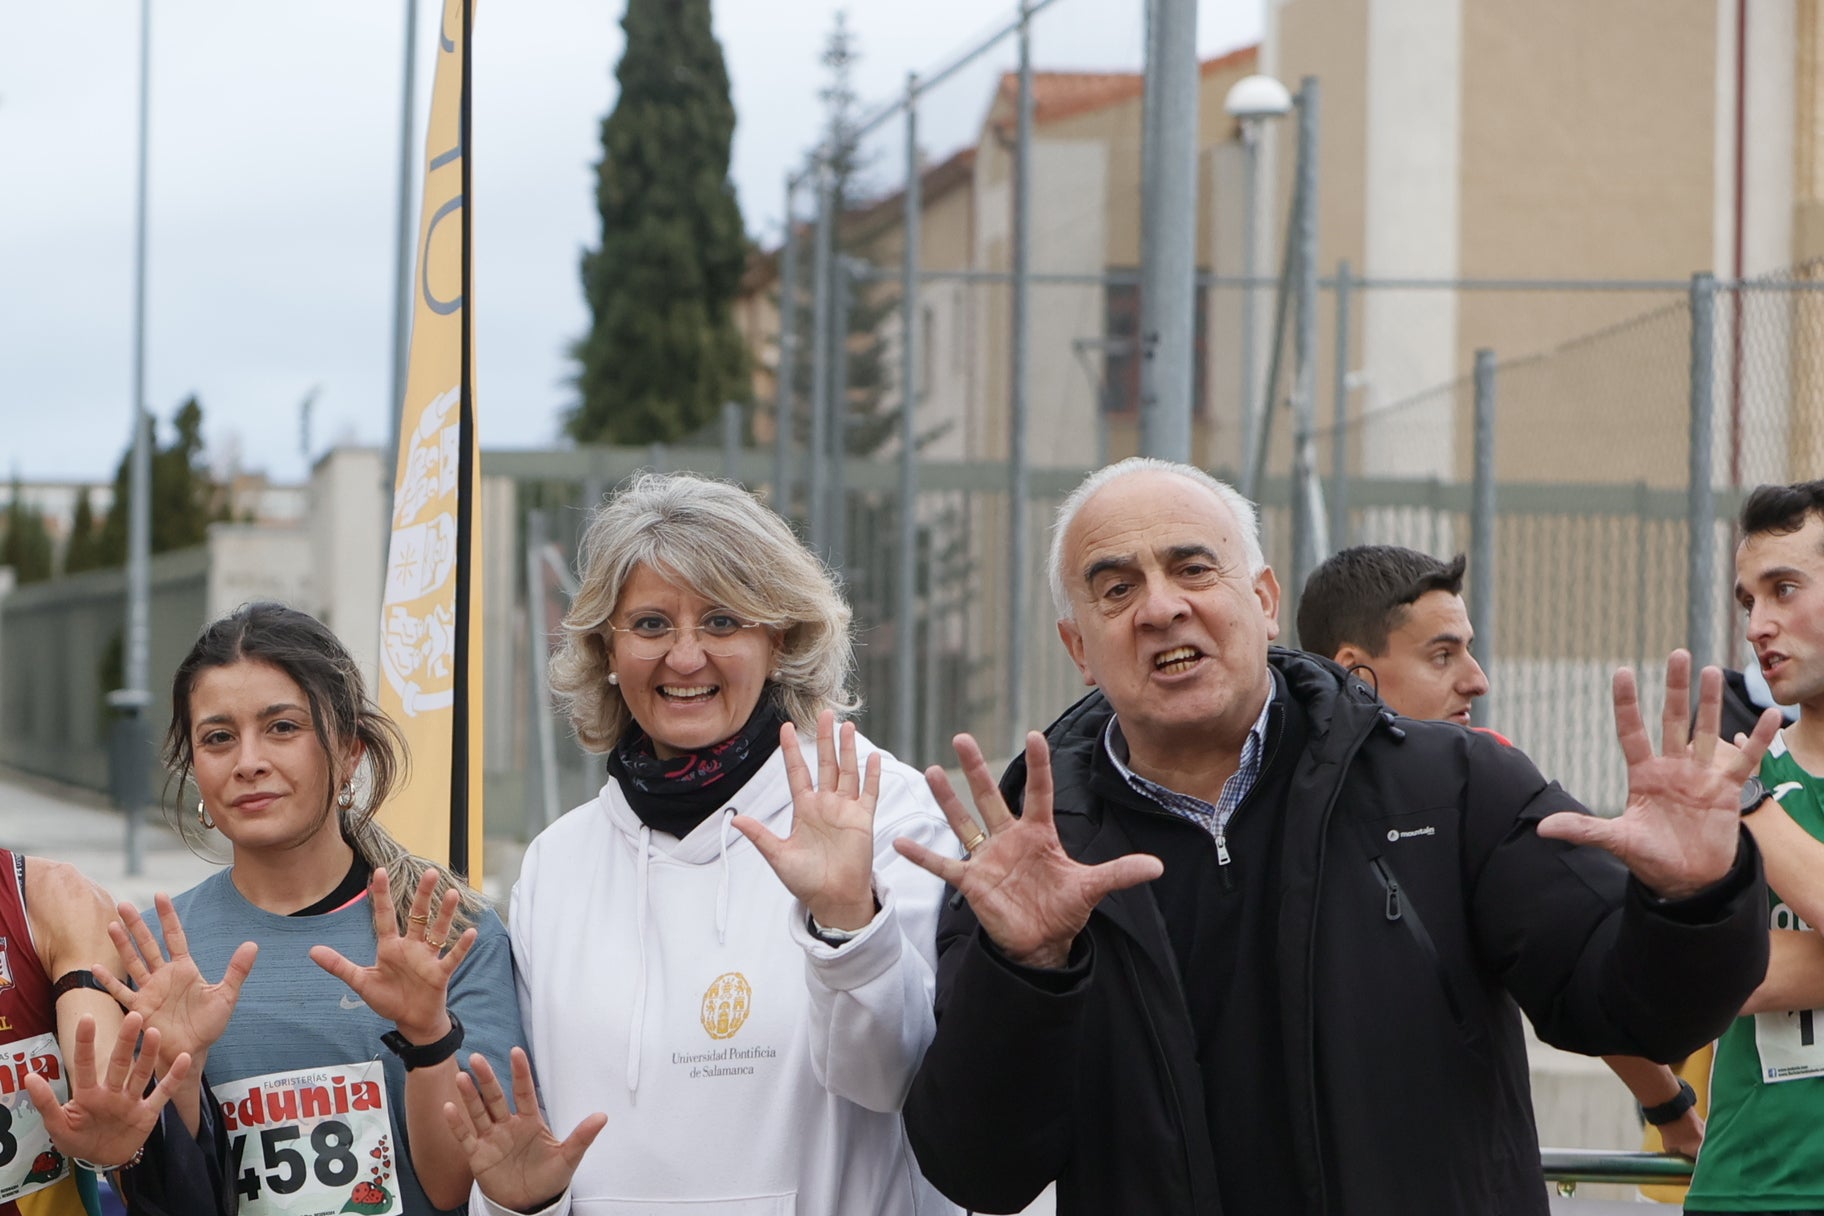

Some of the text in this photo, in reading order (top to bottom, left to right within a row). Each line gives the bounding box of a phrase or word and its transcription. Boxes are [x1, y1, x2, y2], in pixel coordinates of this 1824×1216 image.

[672, 1046, 776, 1064] Universidad Pontificia
[689, 1065, 755, 1078] de Salamanca
[264, 1074, 328, 1090] FLORISTERÍAS
[221, 1075, 383, 1132] edunia
